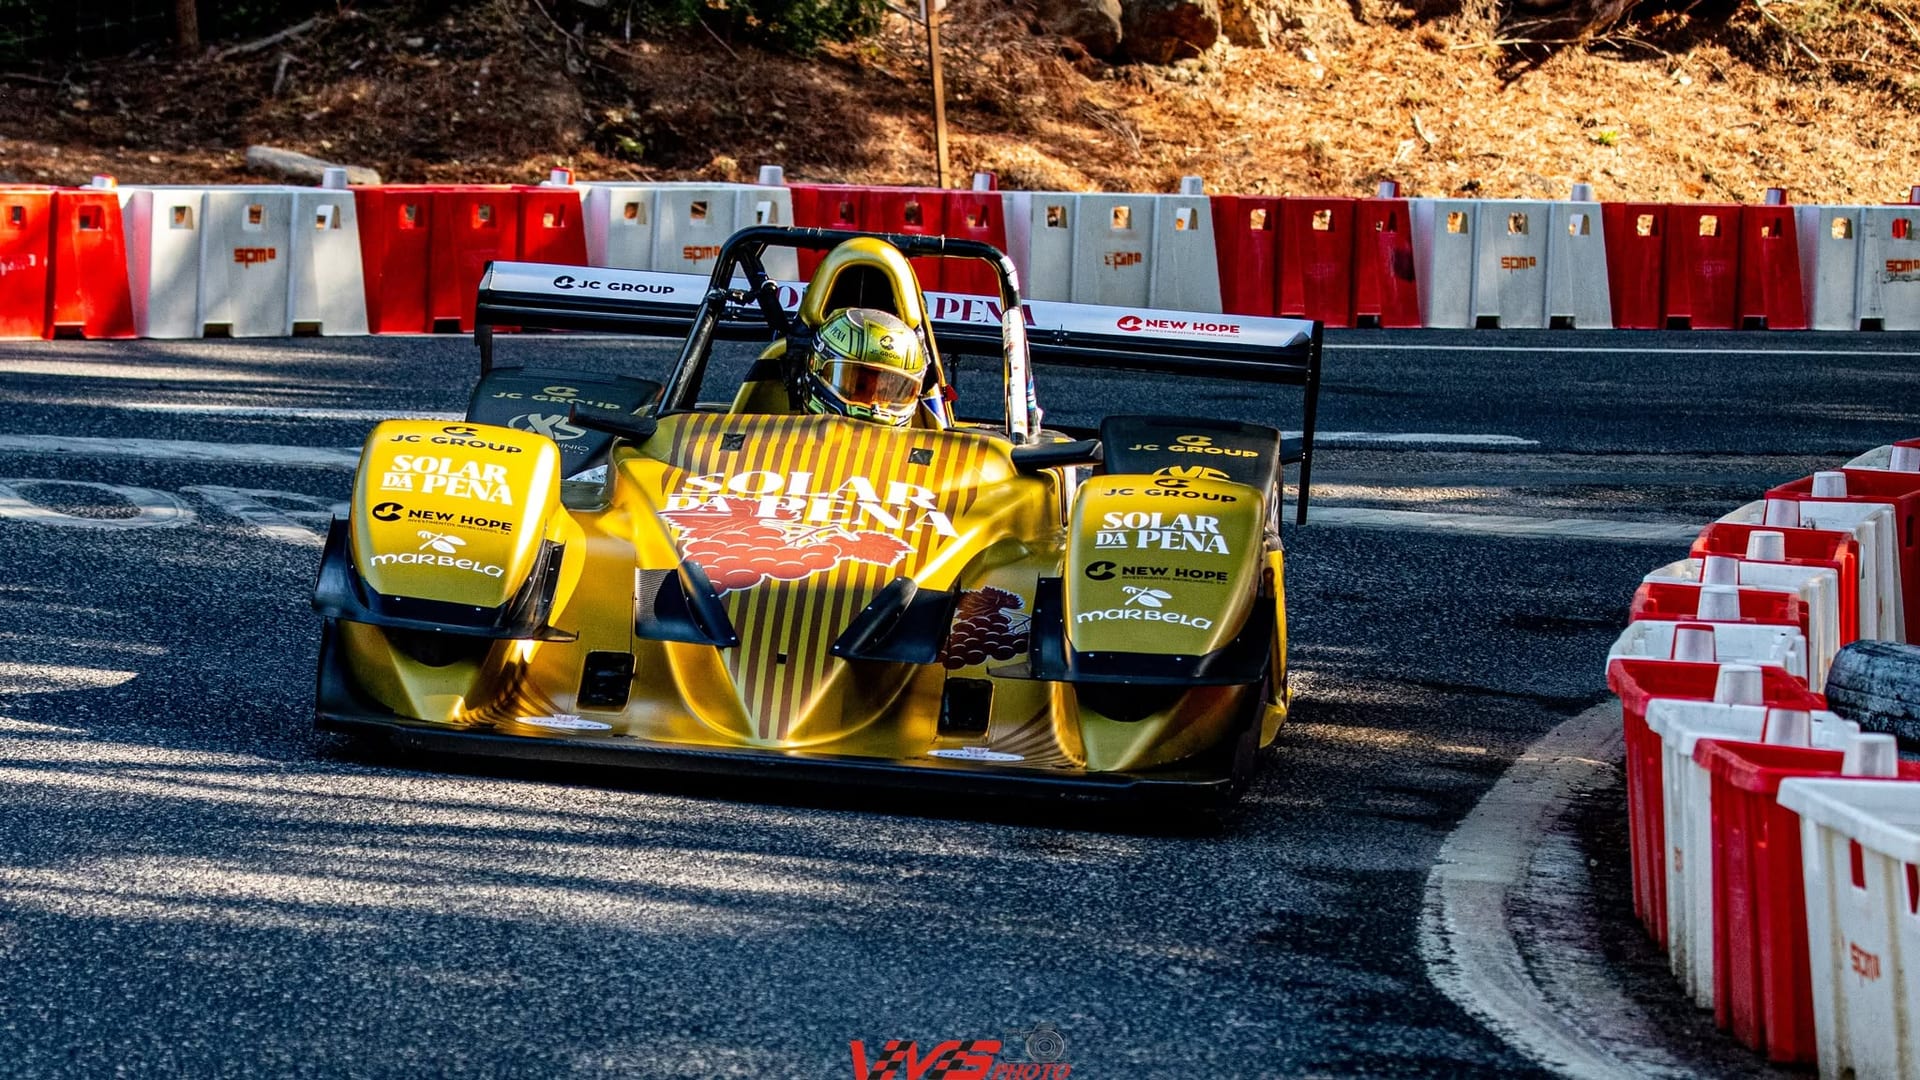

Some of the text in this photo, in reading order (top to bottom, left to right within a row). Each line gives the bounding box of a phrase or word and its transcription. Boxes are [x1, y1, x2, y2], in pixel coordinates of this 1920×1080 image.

[577, 280, 675, 295] JC GROUP
[1146, 319, 1187, 330] NEW
[1192, 322, 1240, 334] HOPE
[390, 435, 522, 454] JC GROUP
[1168, 445, 1259, 457] GROUP
[391, 455, 508, 485] SOLAR
[380, 473, 513, 504] DA PENA
[682, 470, 938, 510] SOLAR
[1144, 489, 1237, 503] GROUP
[408, 510, 513, 532] NEW HOPE
[656, 494, 962, 538] DA PENA
[1103, 512, 1220, 534] SOLAR
[1095, 530, 1230, 555] DA PENA
[1122, 566, 1229, 581] NEW HOPE
